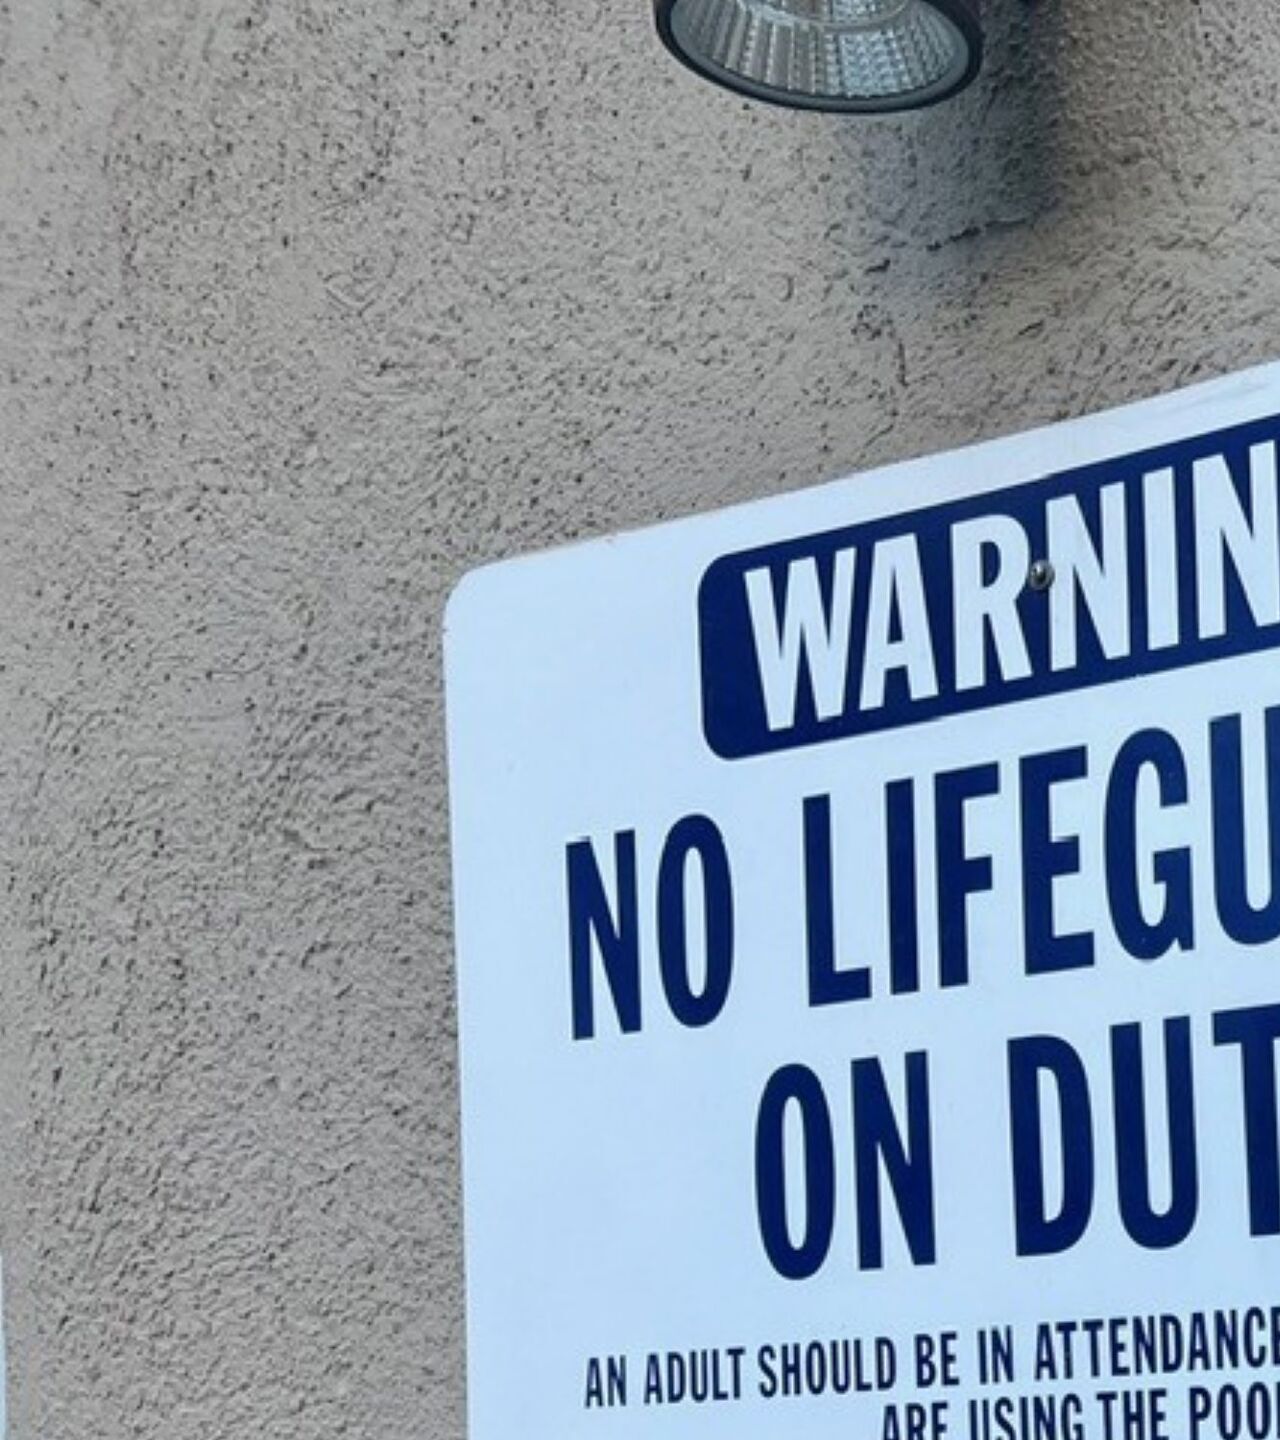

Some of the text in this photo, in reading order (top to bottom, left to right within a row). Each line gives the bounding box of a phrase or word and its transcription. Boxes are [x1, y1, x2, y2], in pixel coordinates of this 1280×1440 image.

[565, 813, 735, 1041] NO
[754, 1049, 937, 1281] ON
[585, 1355, 628, 1409] AN
[643, 1346, 746, 1405] ADULT
[757, 1335, 898, 1399] SHOULD
[914, 1330, 960, 1389] BE
[977, 1325, 1015, 1386] IN
